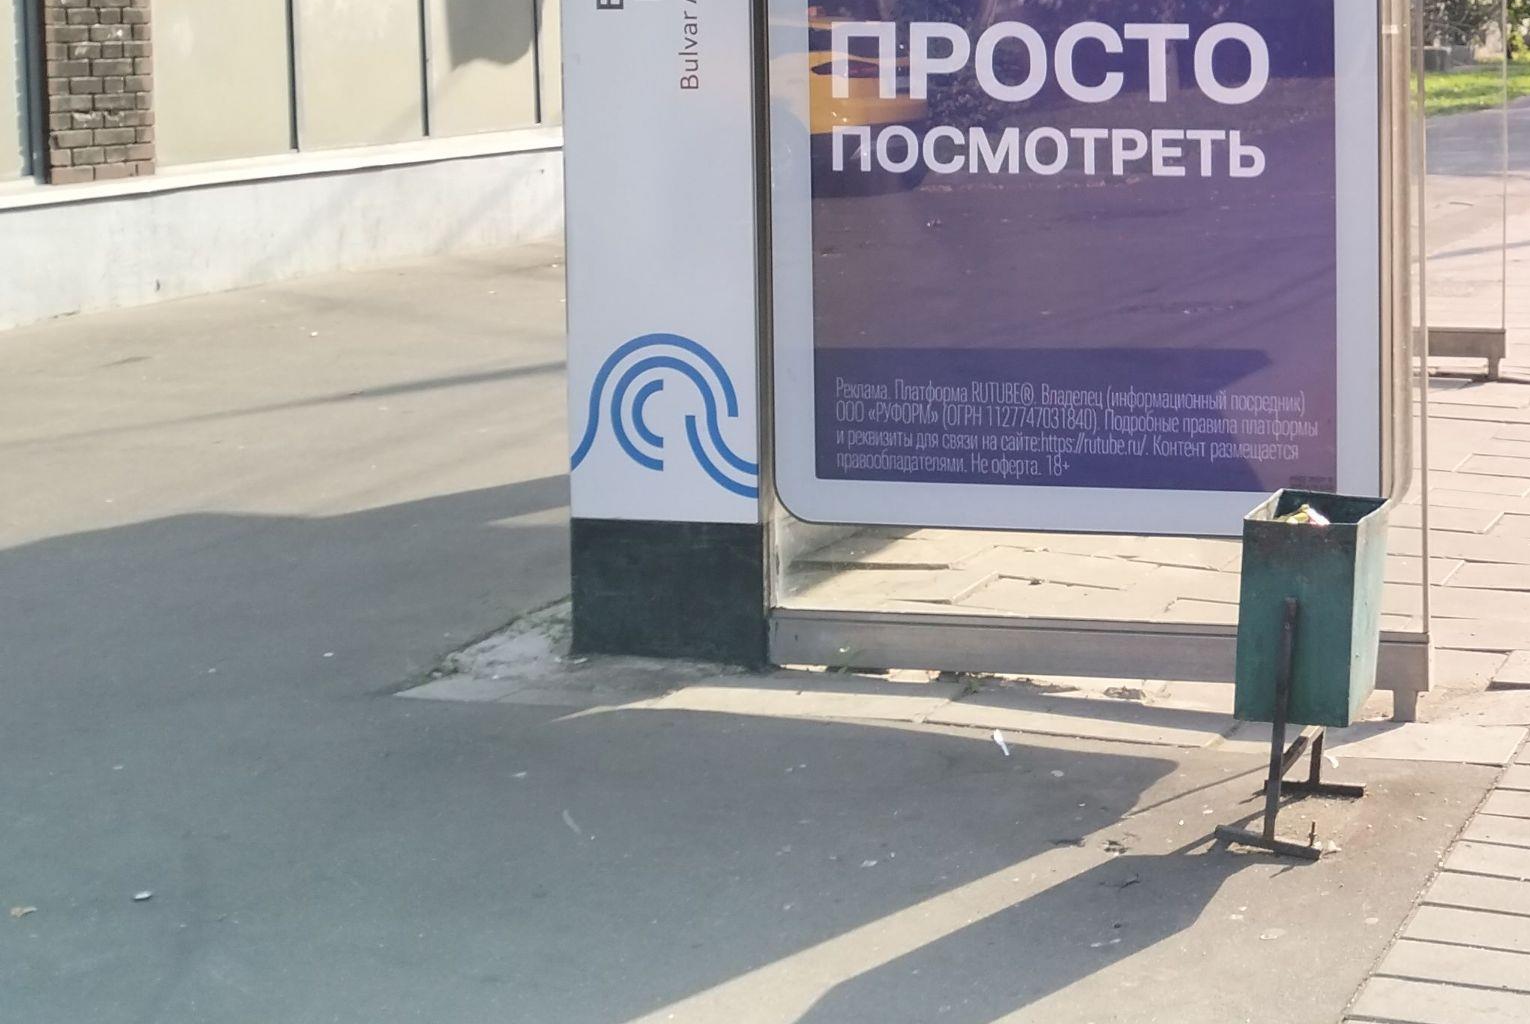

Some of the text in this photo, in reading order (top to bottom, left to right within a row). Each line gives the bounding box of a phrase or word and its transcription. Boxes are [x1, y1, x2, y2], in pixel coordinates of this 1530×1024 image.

[679, 11, 700, 90] Bulvar
[830, 21, 1270, 104] ПРОСТО
[831, 125, 1266, 178] ПОСМОТРЕТЬ
[836, 377, 891, 400] Реклама.
[895, 378, 968, 405] Платформа
[1041, 383, 1103, 410] Владелец
[1106, 384, 1227, 412] (информационный
[836, 400, 864, 422] ООО
[868, 401, 939, 425] «РУФОРМ»
[942, 403, 983, 430] (ОГРН
[1104, 408, 1180, 437] Подробные
[1182, 415, 1238, 438] правила
[1241, 417, 1319, 441] платформы
[836, 430, 844, 445] и
[848, 430, 913, 450] реквизиты
[915, 432, 939, 451] для
[942, 433, 978, 452] связи
[982, 434, 997, 451] на
[1153, 434, 1206, 457] Контент
[1210, 441, 1299, 464] размещается
[836, 448, 1071, 479] правообладателями. Не оферта. 18+
